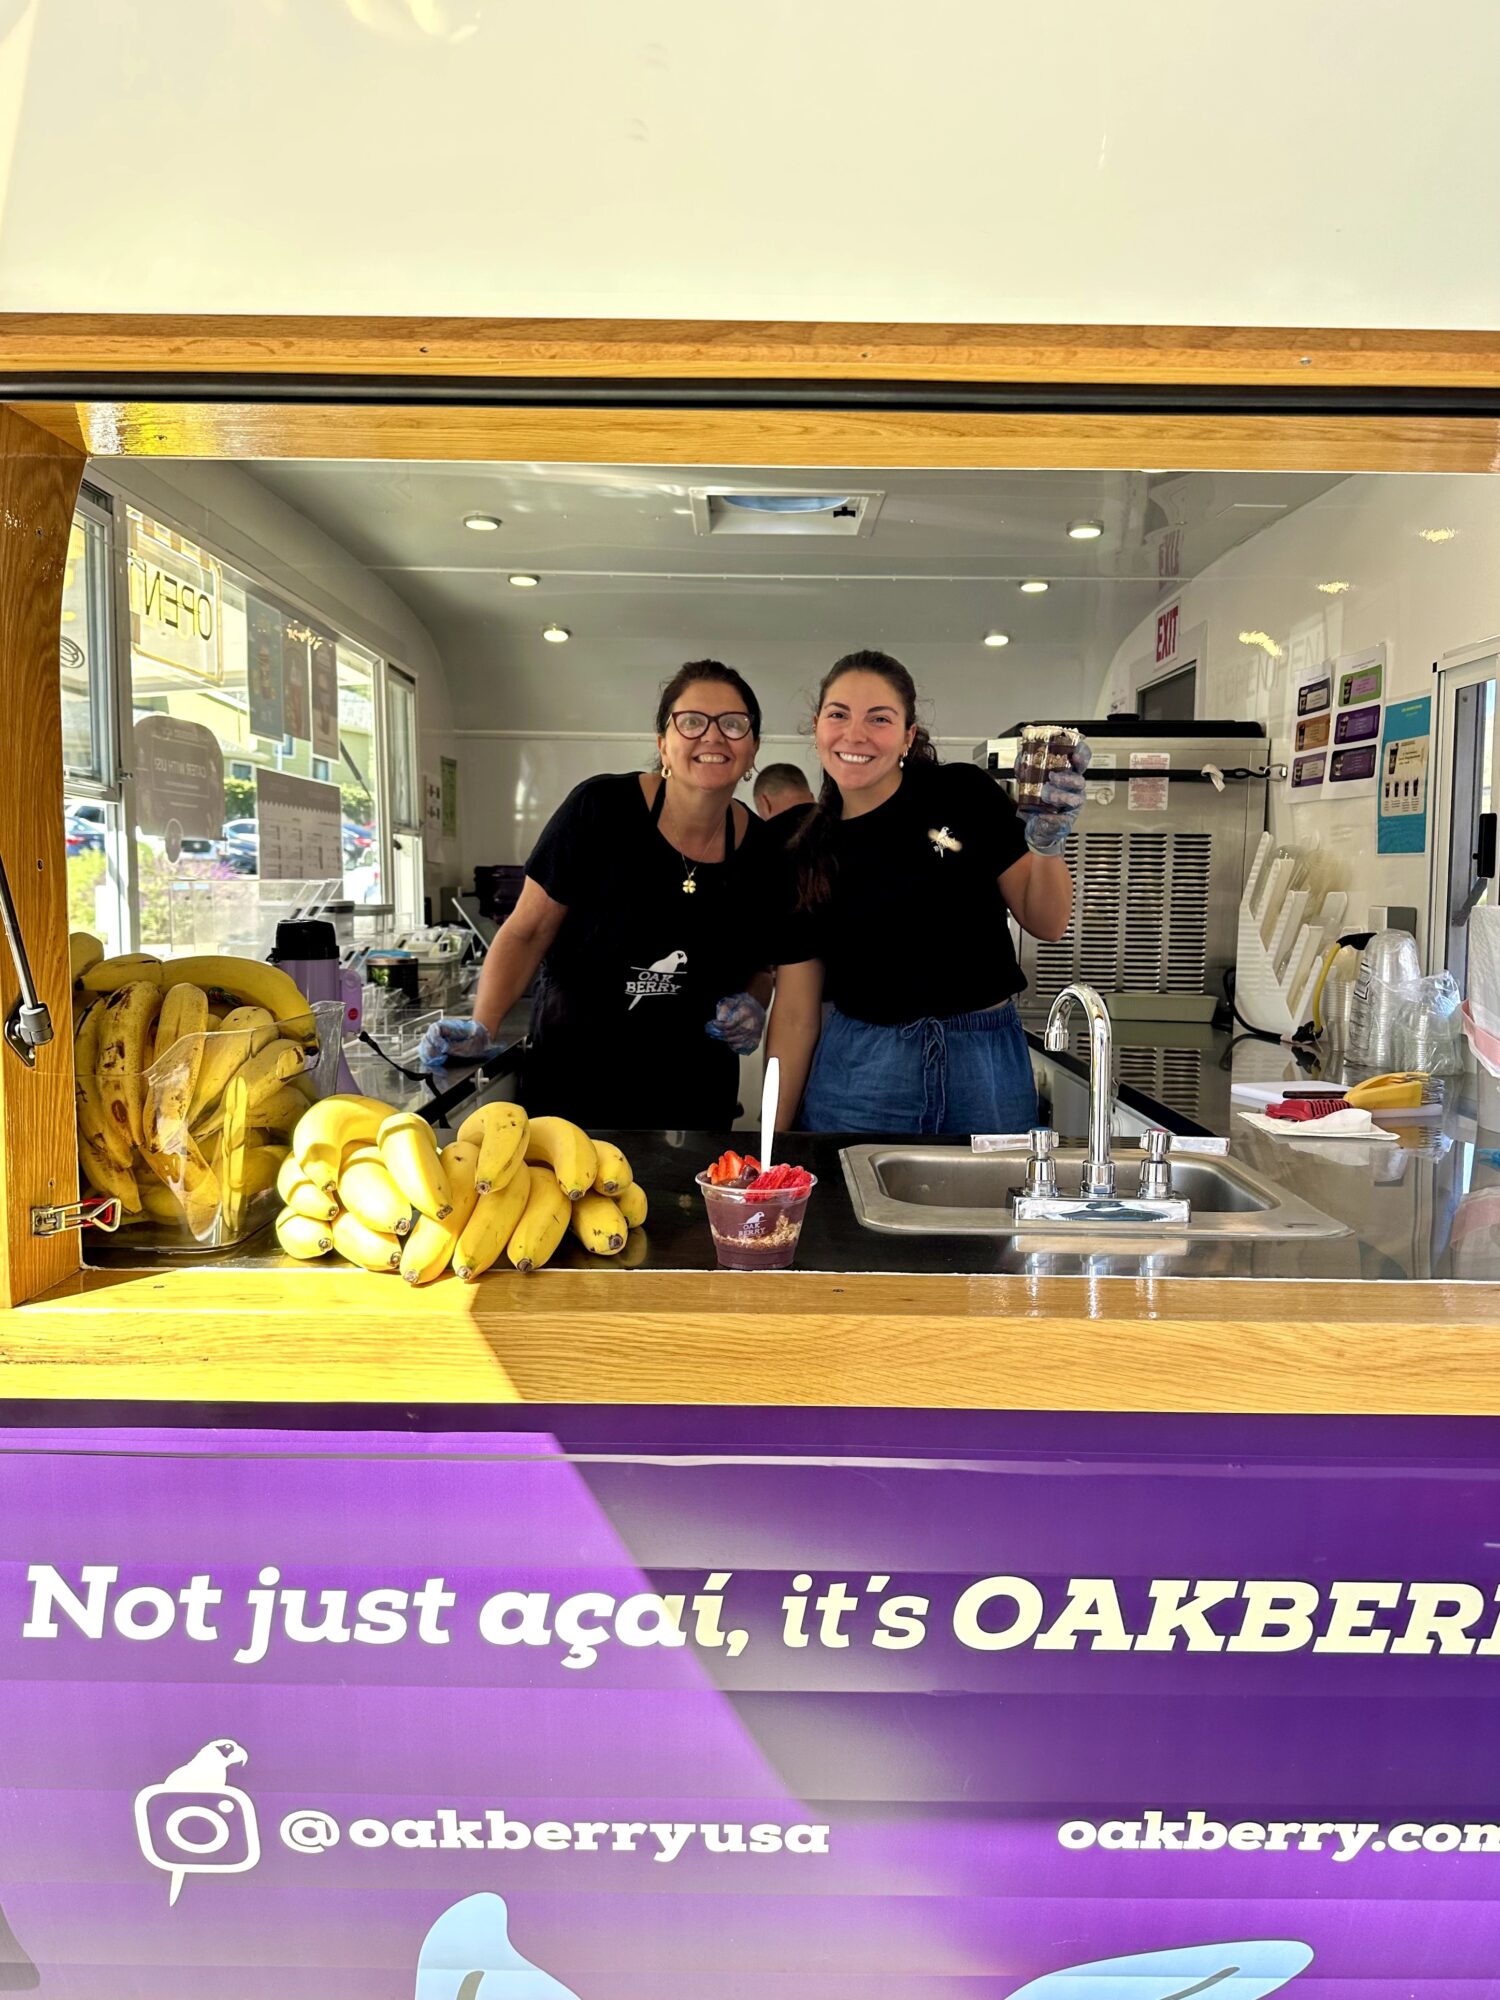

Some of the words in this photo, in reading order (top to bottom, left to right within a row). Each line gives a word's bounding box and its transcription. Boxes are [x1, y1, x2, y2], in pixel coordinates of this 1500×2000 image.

[1156, 605, 1179, 663] EXIT
[638, 971, 674, 983] OAK
[625, 981, 682, 993] BERRY
[738, 1227, 766, 1237] BERRY
[743, 1222, 761, 1231] OAK
[22, 1564, 222, 1641] Not
[233, 1566, 456, 1665] just
[479, 1572, 750, 1669] açaí,
[781, 1573, 930, 1649] it's
[952, 1575, 1500, 1655] OAKBER
[280, 1809, 830, 1862] @oakberryusa
